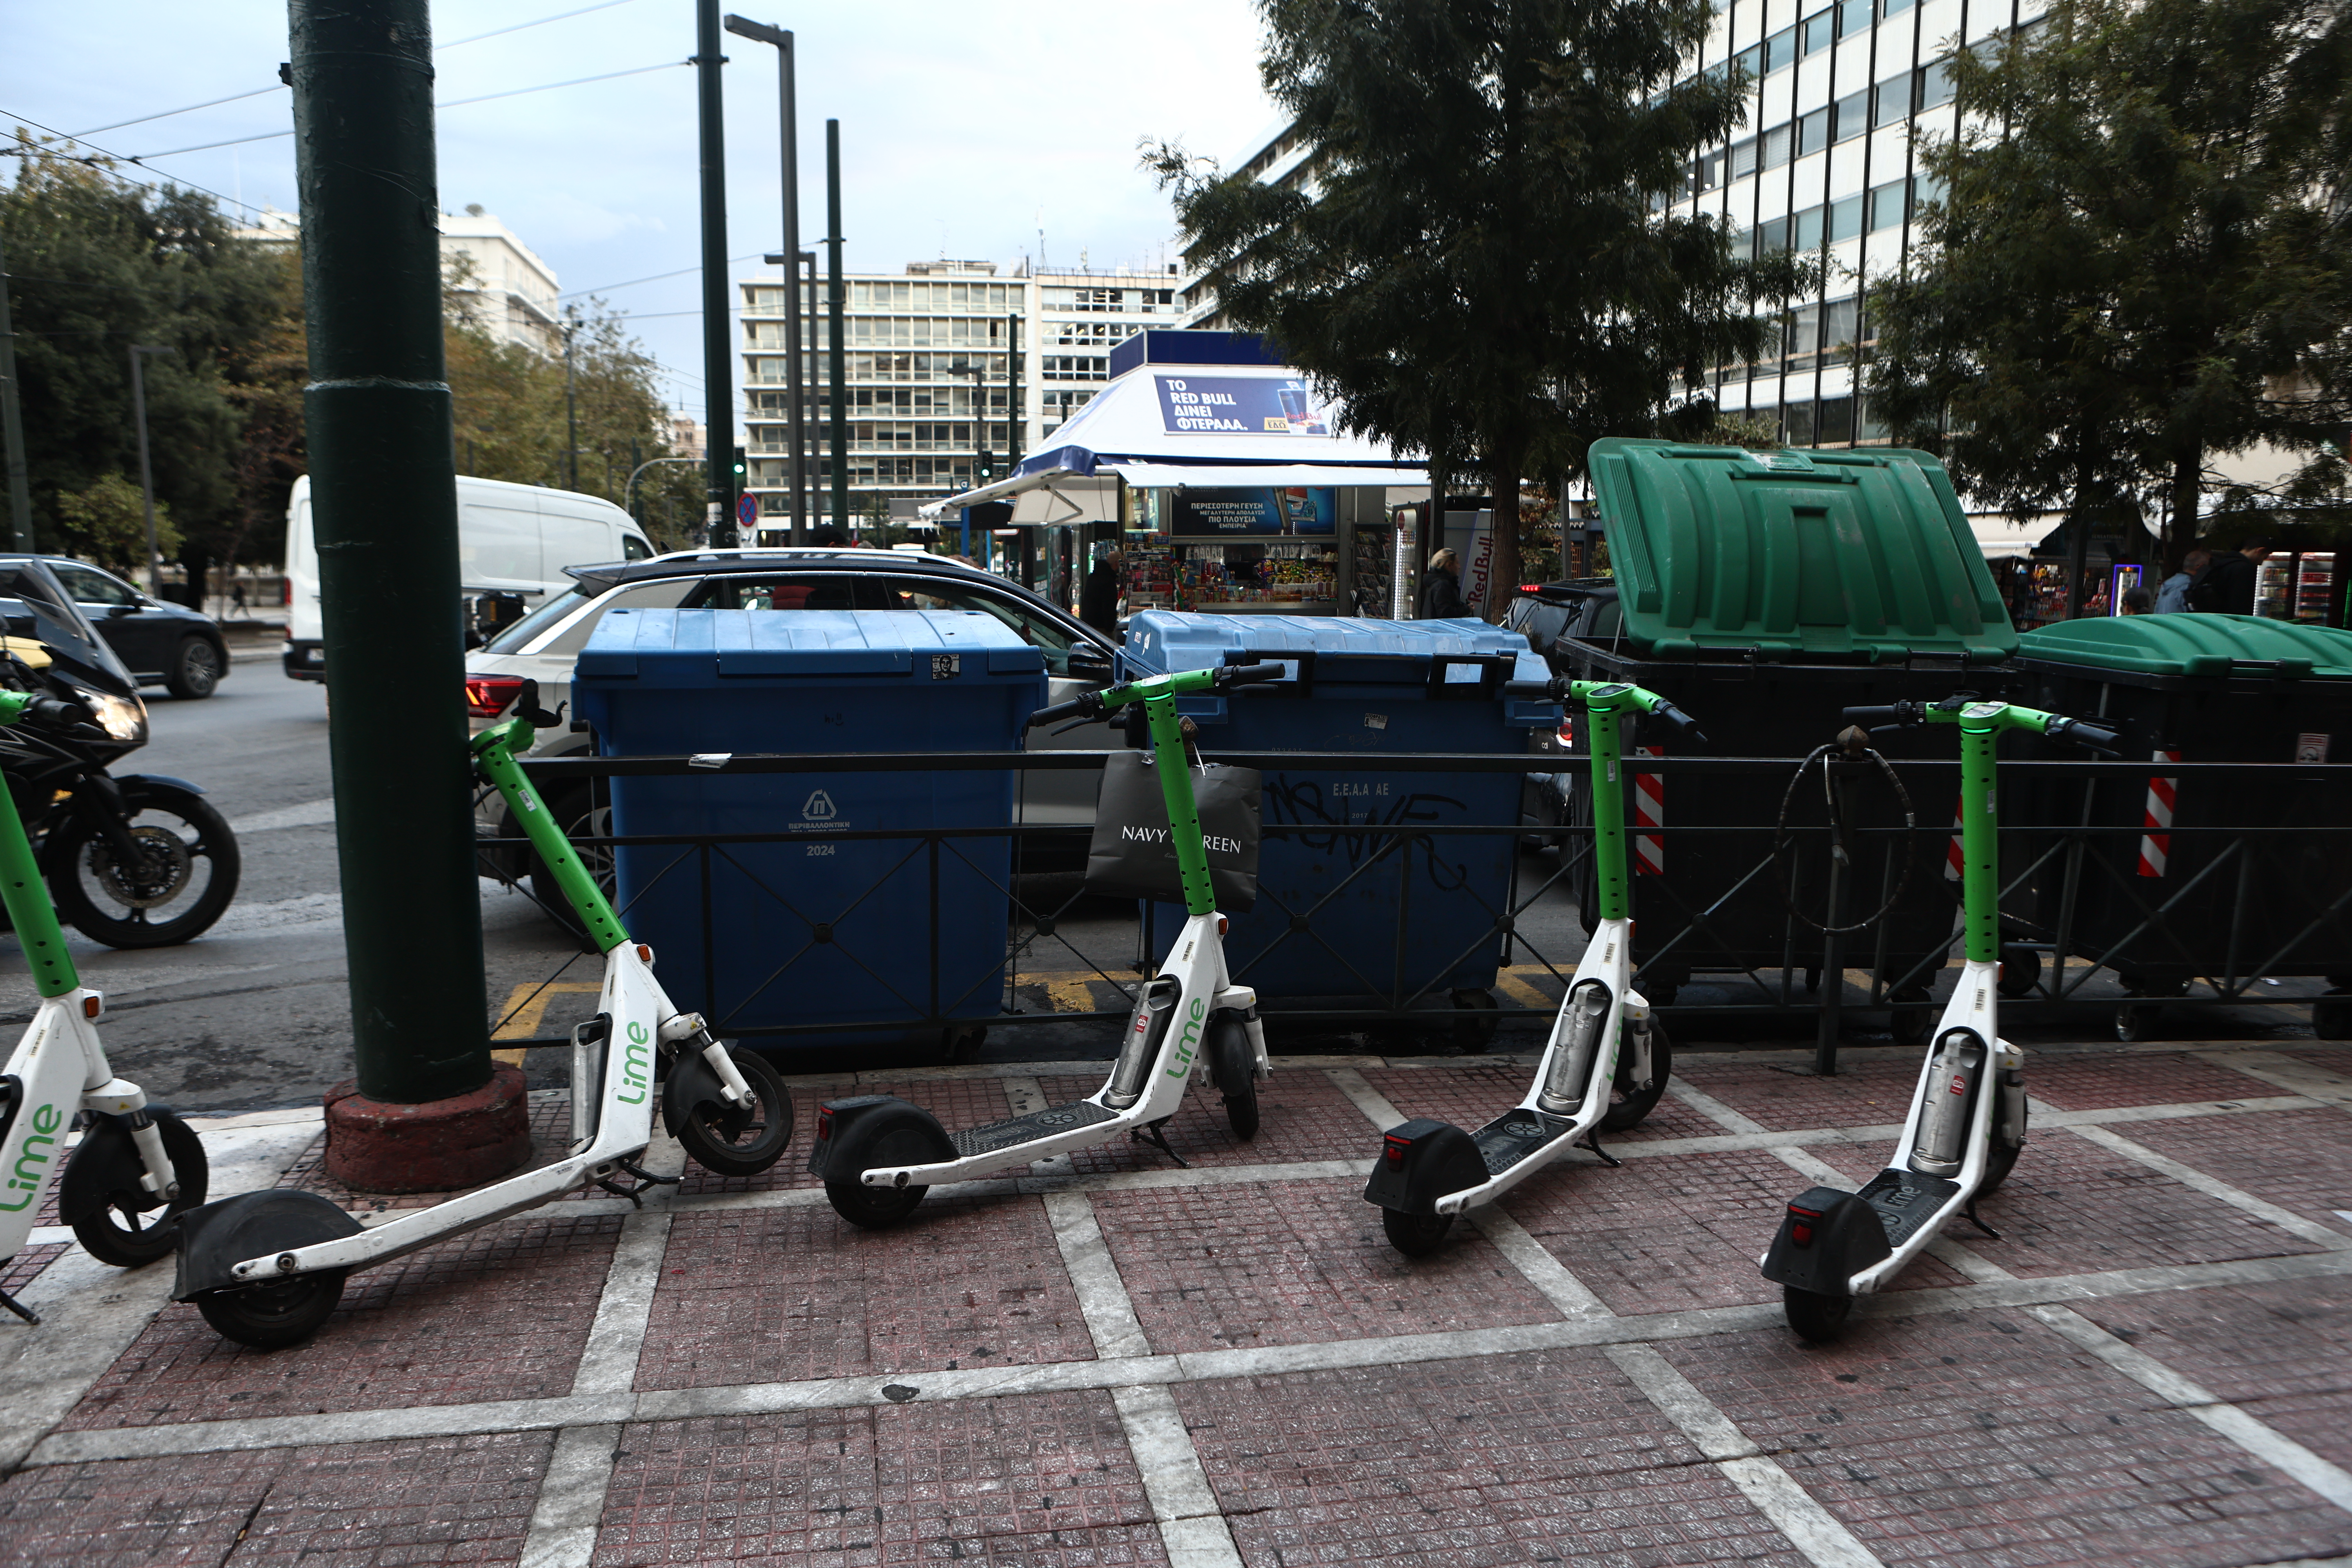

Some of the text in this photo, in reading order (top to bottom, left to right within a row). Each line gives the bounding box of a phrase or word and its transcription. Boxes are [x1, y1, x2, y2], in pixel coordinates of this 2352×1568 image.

[1166, 379, 1187, 392] ΤΟ
[1171, 392, 1237, 405] RED BULL
[1174, 405, 1212, 417] ΔΙΝΕΙ
[1177, 417, 1249, 431] ΦΤΕΡΑΑΑ.
[1467, 536, 1494, 603] Red Bull
[806, 844, 835, 856] 2024
[1122, 825, 1241, 854] NAVY REEN
[1166, 997, 1205, 1079] Lime
[617, 1020, 649, 1105] Lime
[0, 1103, 63, 1211] Lime
